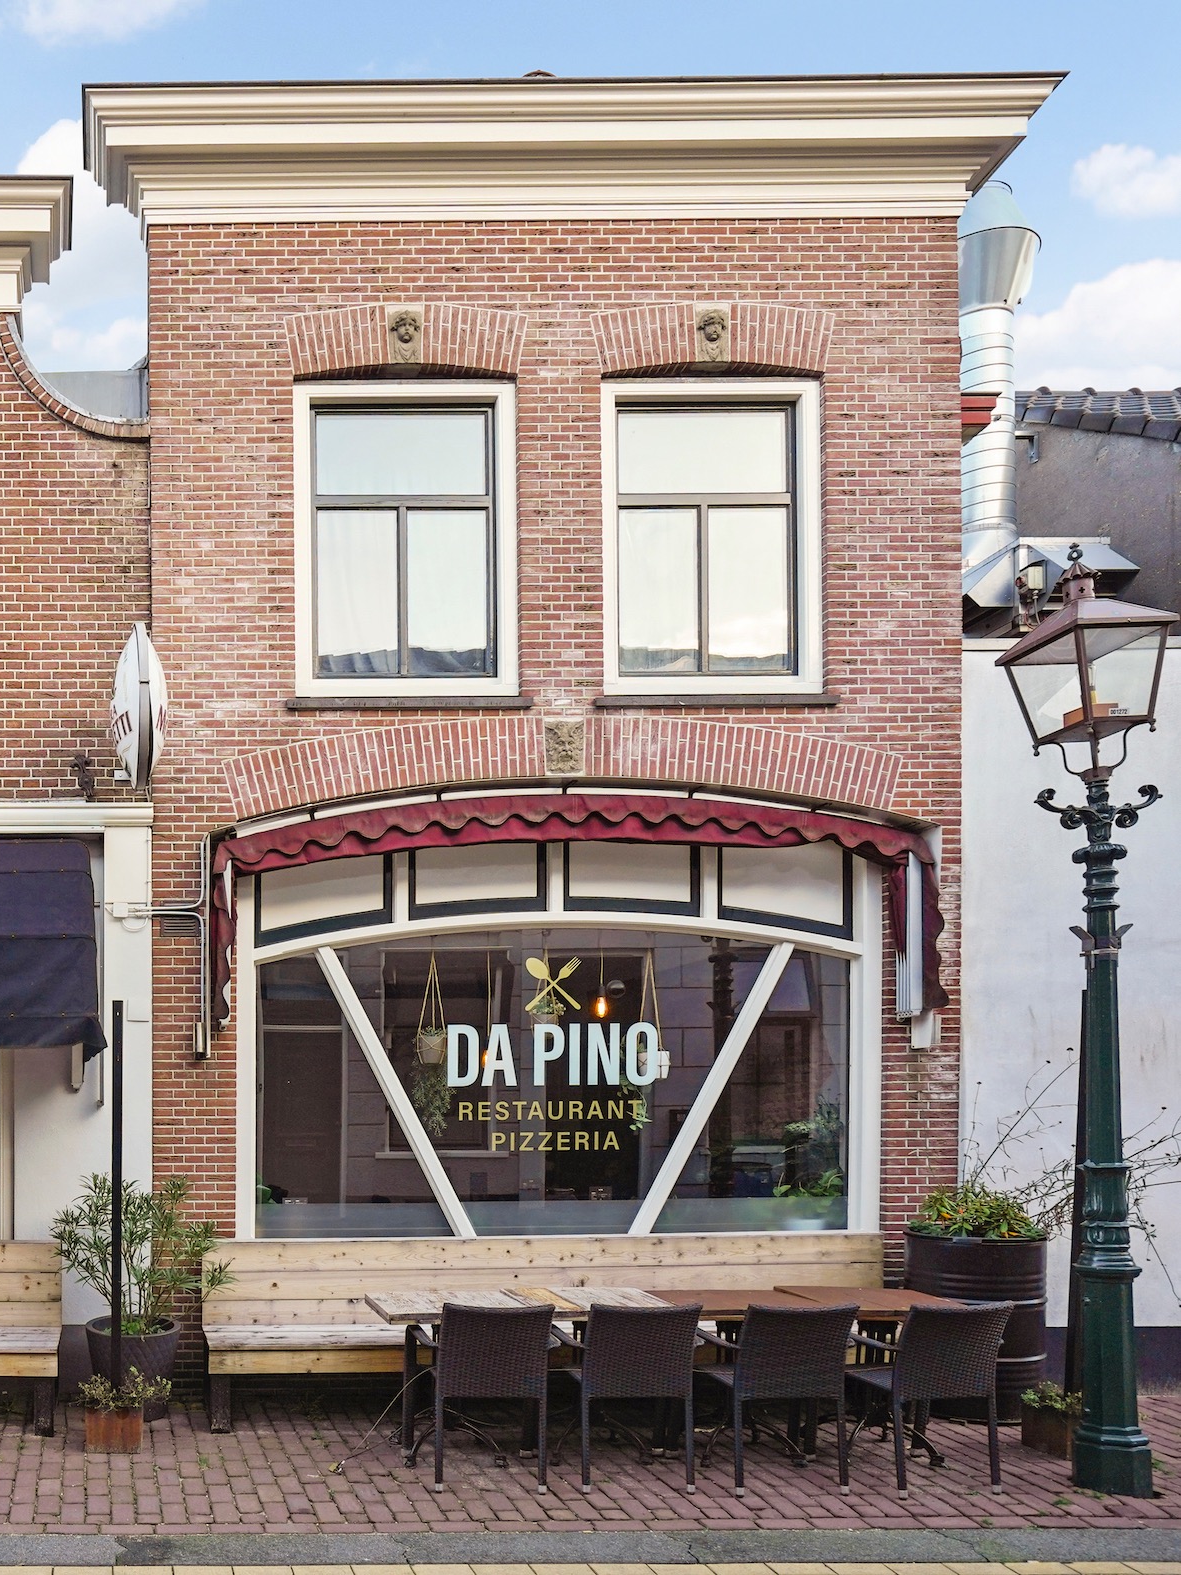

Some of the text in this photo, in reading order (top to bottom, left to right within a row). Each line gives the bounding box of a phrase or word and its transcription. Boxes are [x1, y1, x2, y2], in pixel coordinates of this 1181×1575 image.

[447, 1022, 659, 1087] DA PINO
[458, 1100, 643, 1121] RESTAURANT
[491, 1131, 620, 1151] PIZZERIA
